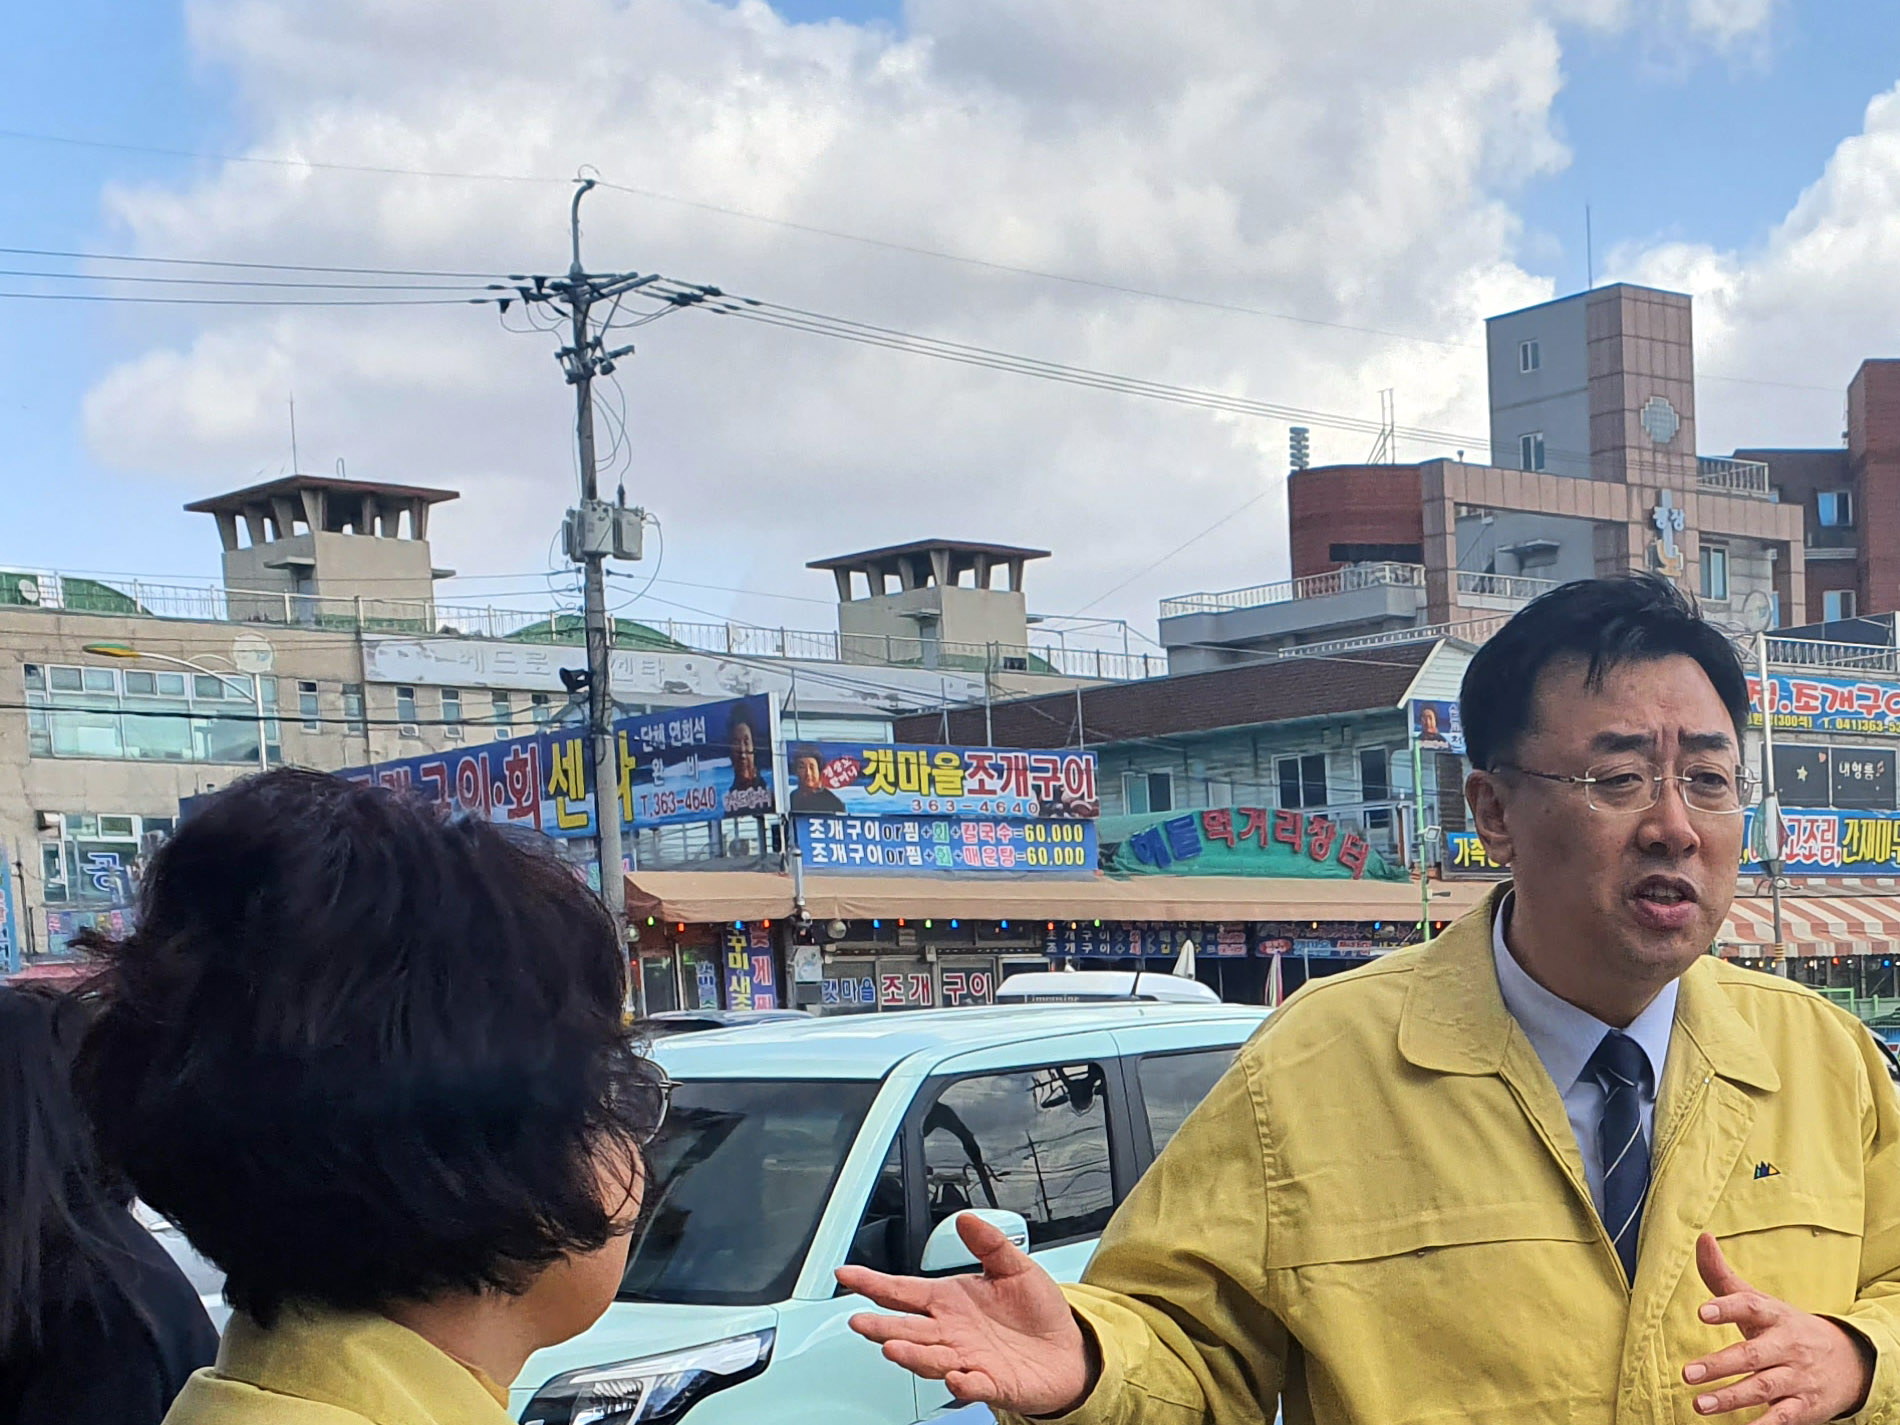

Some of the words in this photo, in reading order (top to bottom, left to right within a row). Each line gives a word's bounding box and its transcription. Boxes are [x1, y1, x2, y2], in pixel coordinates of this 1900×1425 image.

[862, 749, 964, 797] 갯마을
[964, 751, 1097, 802] 조개구이
[1203, 807, 1369, 880] 먹거리장터
[822, 976, 876, 1005] 갯마을
